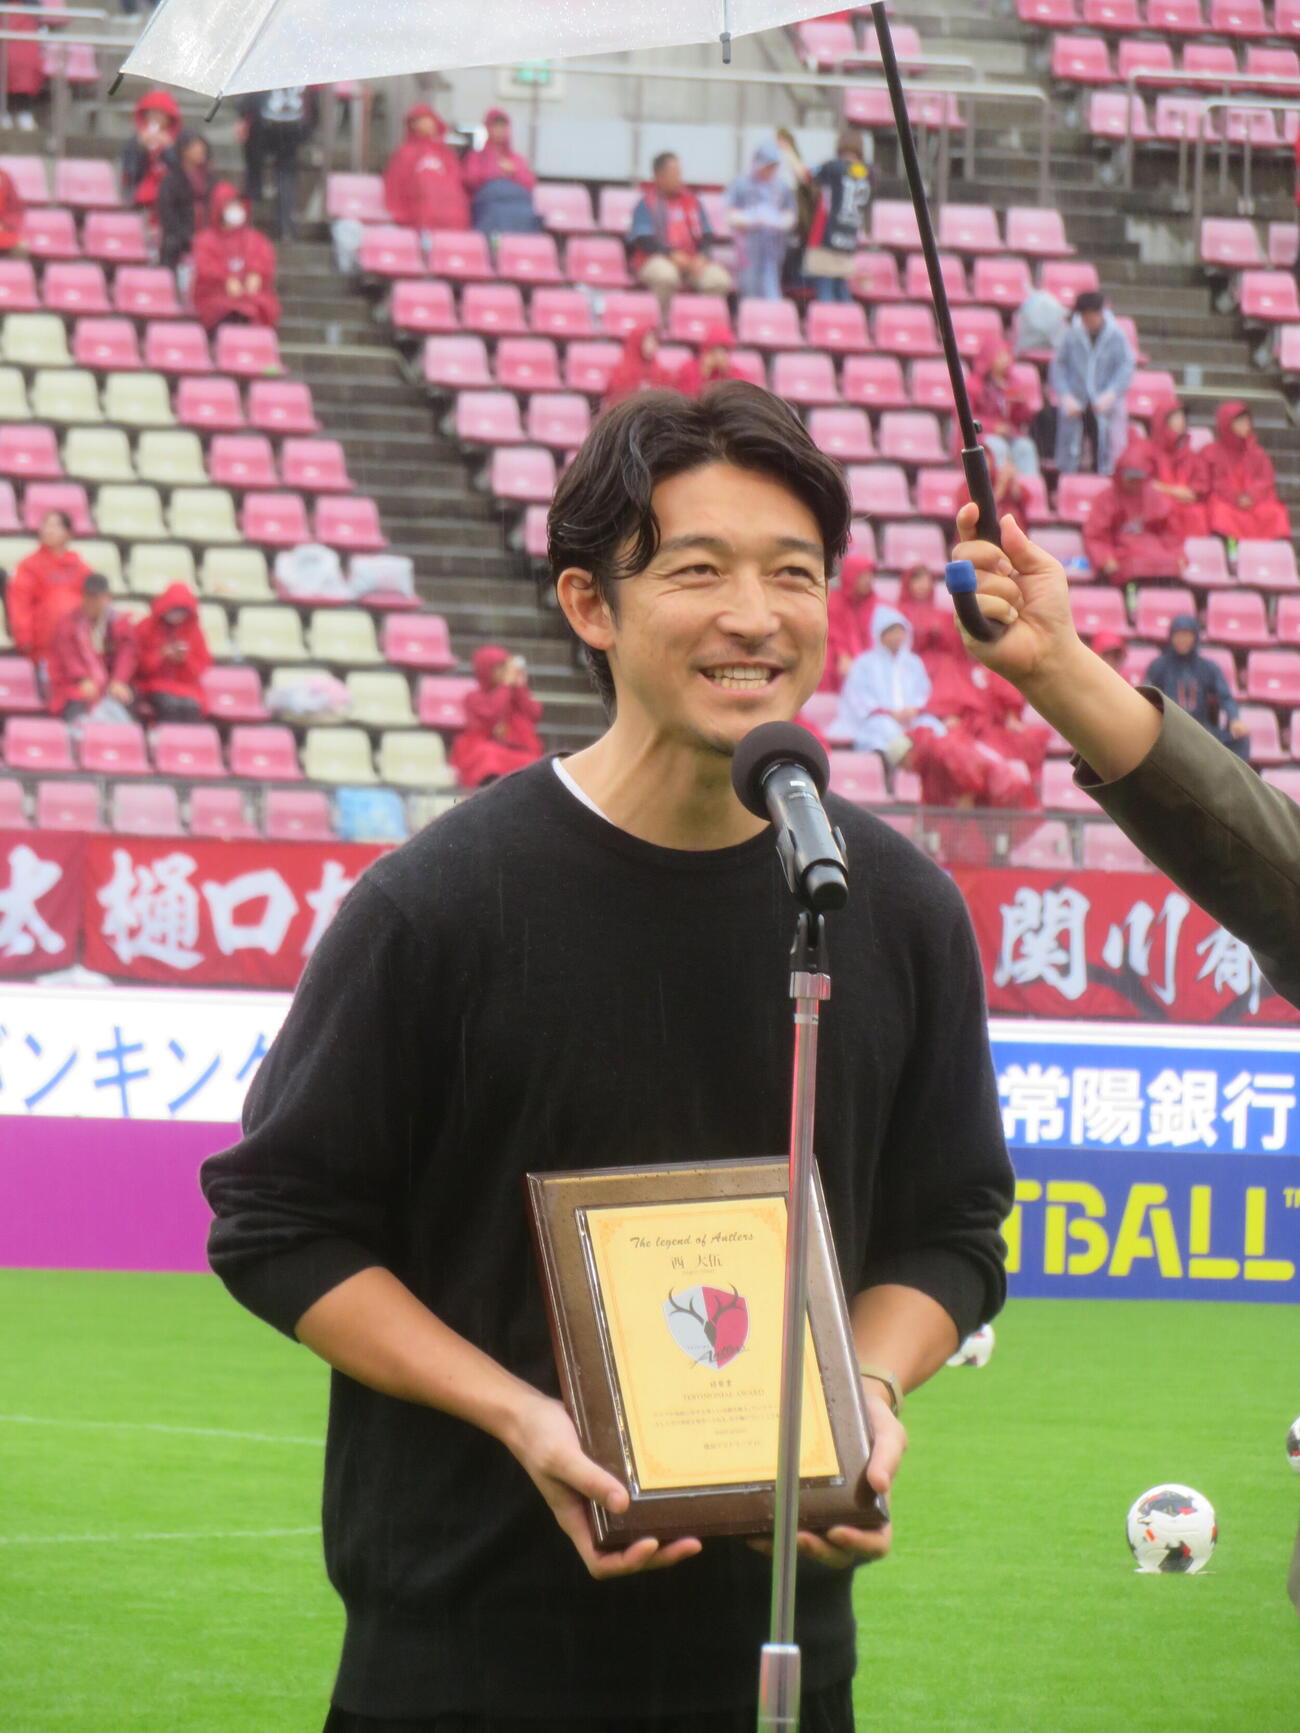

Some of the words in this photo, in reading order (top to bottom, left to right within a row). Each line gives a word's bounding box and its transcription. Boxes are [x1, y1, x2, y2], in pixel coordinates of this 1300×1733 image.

[0, 1025, 269, 1118] ンキン
[1000, 1063, 1295, 1151] 常陽銀行
[629, 1236, 651, 1248] The
[655, 1233, 692, 1249] legend
[695, 1234, 707, 1247] of
[709, 1231, 754, 1244] Antlers
